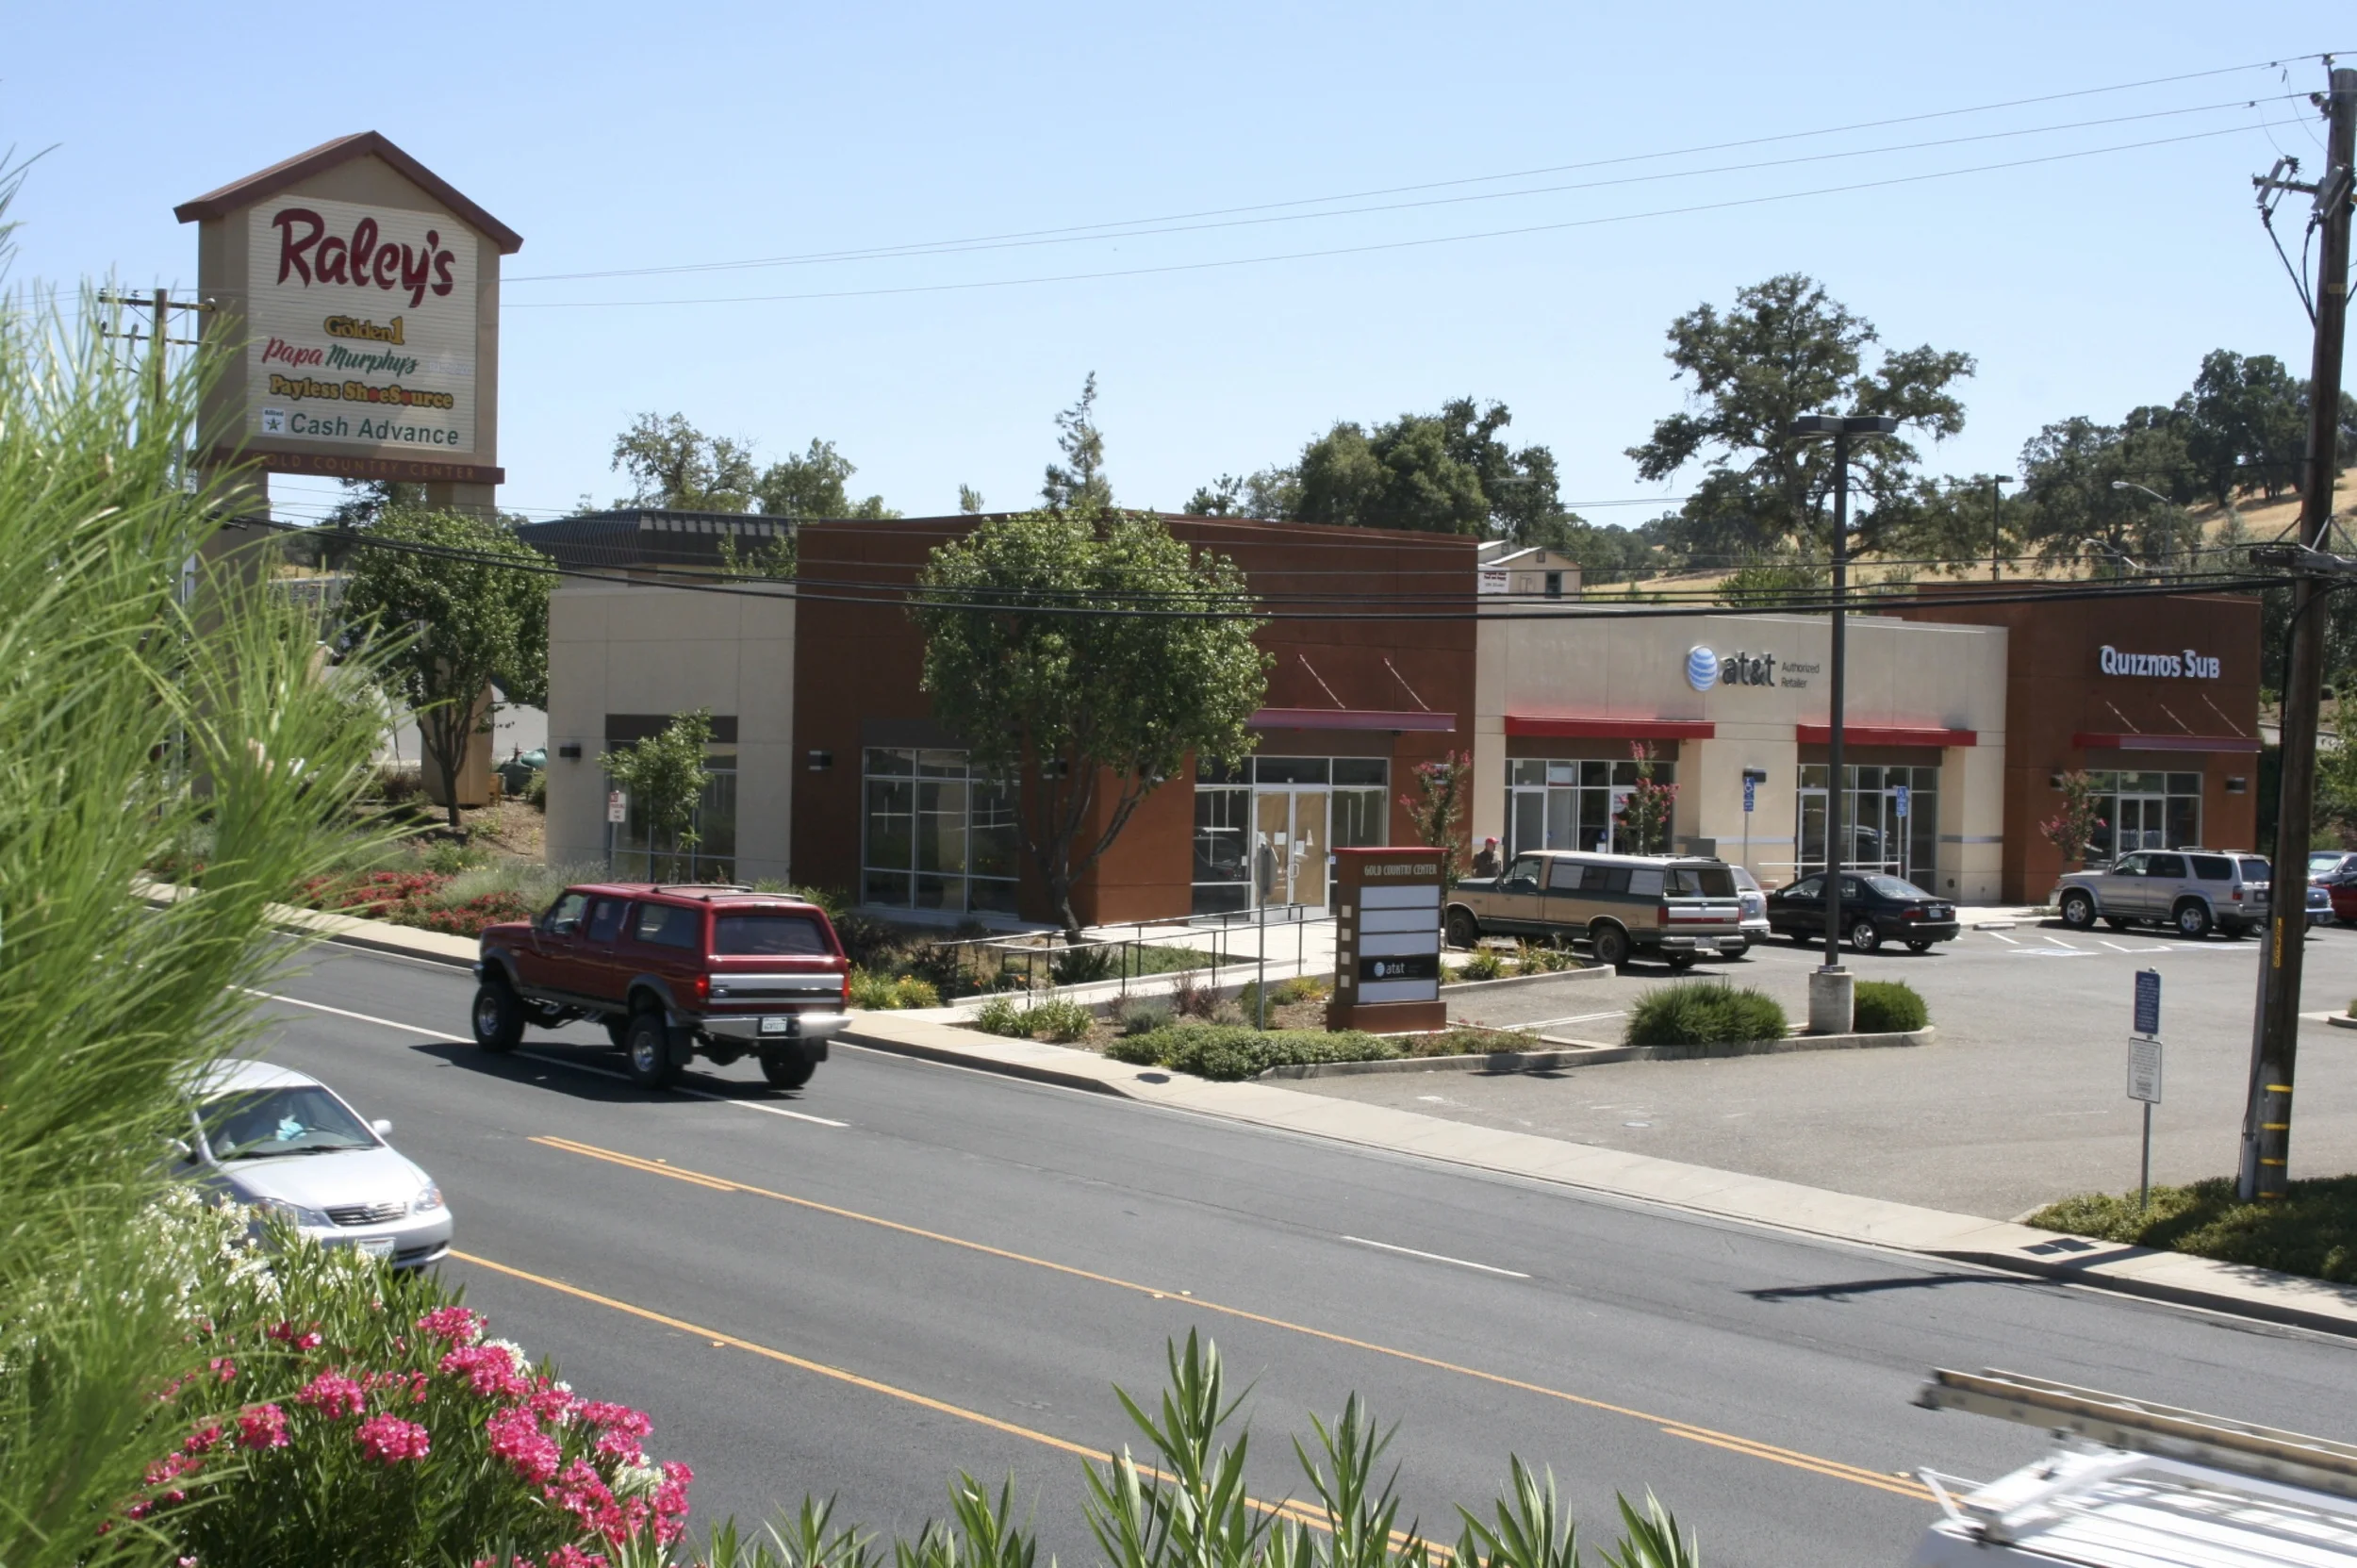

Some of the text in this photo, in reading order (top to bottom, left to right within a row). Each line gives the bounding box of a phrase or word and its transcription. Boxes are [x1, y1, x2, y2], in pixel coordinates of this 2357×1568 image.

[272, 207, 456, 308] Raley's
[262, 338, 323, 368] Papa
[325, 343, 420, 377] Murphy's
[269, 374, 453, 409] Payless ShoeSource
[290, 413, 459, 445] Cash Advance
[314, 456, 399, 473] COUNTRY
[409, 464, 475, 479] CENTER
[1722, 651, 1776, 687] at&t
[1781, 662, 1821, 674] Authorized
[1780, 677, 1807, 688] Retailer
[1364, 864, 1438, 876] GOLD COUNTRY CENTER
[1386, 962, 1406, 975] at&t
